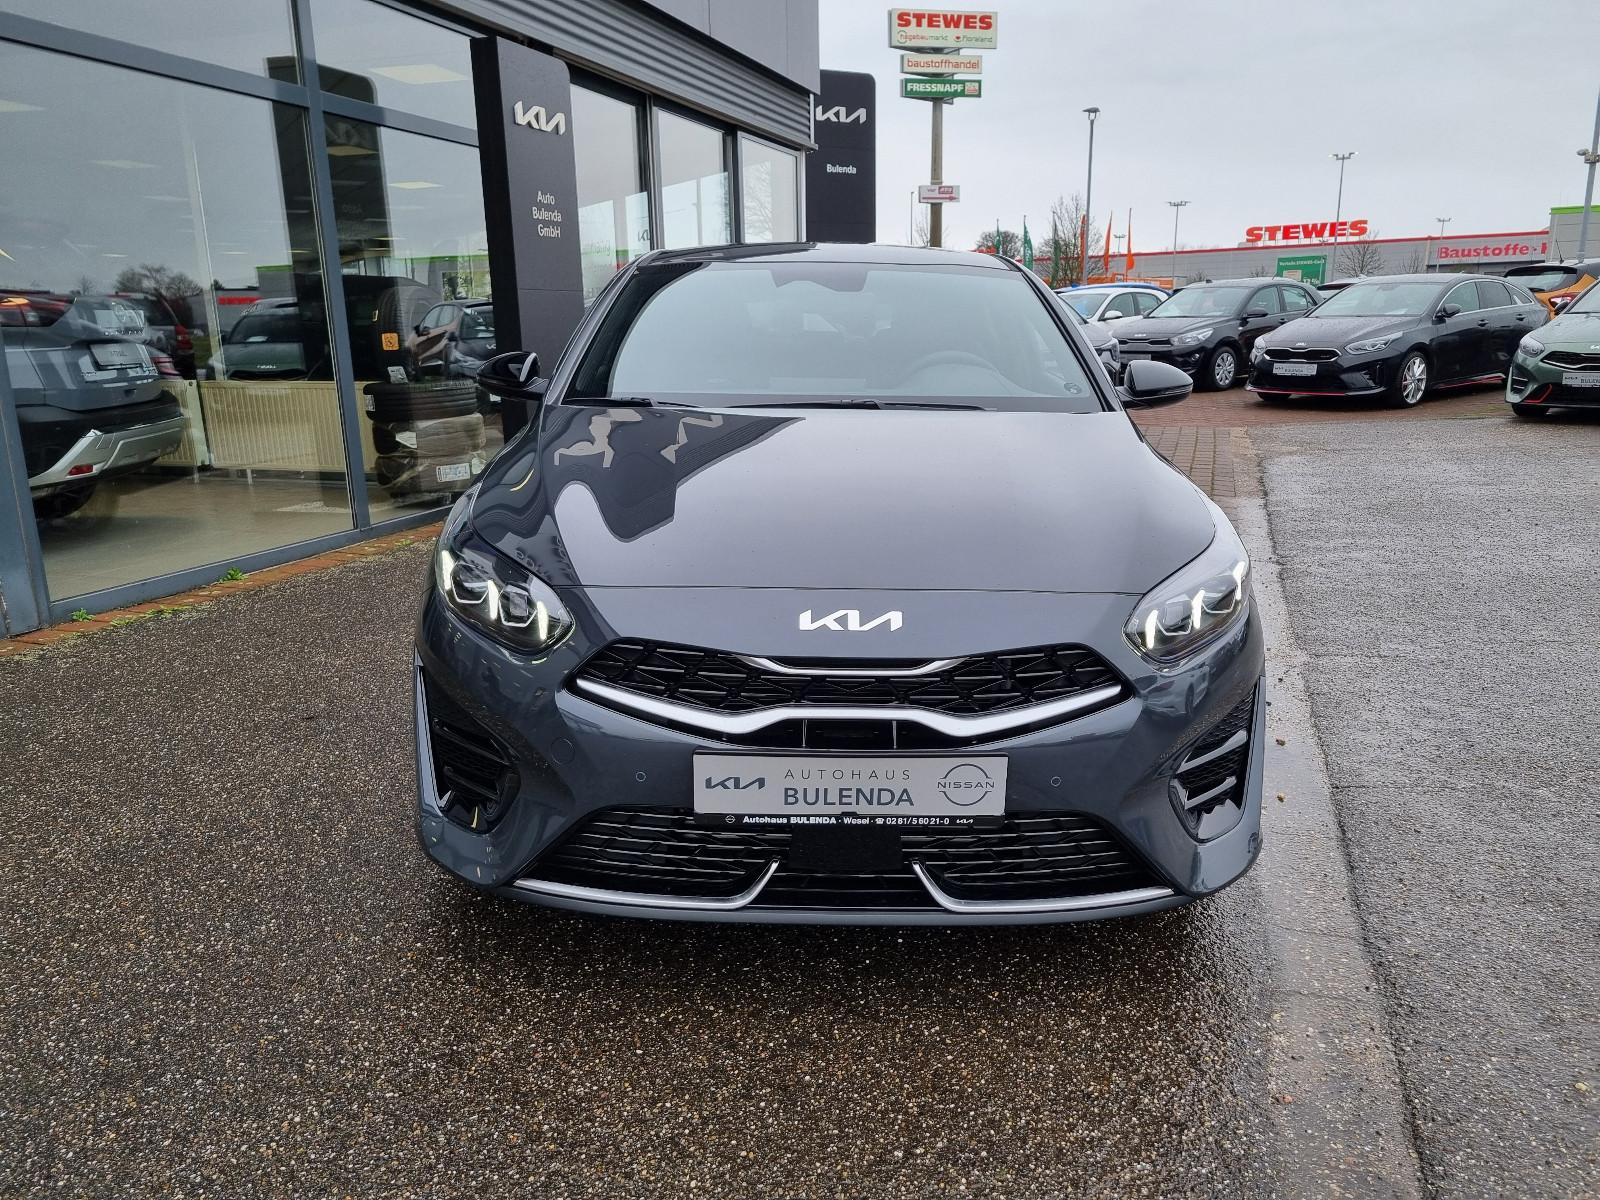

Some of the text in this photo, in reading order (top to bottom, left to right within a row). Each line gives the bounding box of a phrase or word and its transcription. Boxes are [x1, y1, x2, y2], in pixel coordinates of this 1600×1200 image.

[897, 12, 993, 30] STEWES
[907, 57, 980, 70] baustoffhandel
[907, 82, 964, 93] FRESSNAPF
[513, 100, 566, 136] KIA
[815, 105, 867, 124] KIA
[826, 163, 857, 175] Bulenda
[536, 190, 555, 205] Auto
[532, 206, 562, 222] Bulenda
[537, 223, 561, 238] GmbH
[1245, 219, 1368, 243] STEWES
[1439, 243, 1530, 259] Baustoffe
[799, 609, 903, 632] KIA
[784, 768, 911, 781] AUTOHAUS
[704, 776, 766, 790] KIA
[937, 781, 995, 789] NISSAN
[783, 787, 915, 807] BULENDA
[742, 815, 788, 824] Autohaus
[790, 815, 837, 825] BULENDA
[843, 817, 870, 825] Wesel
